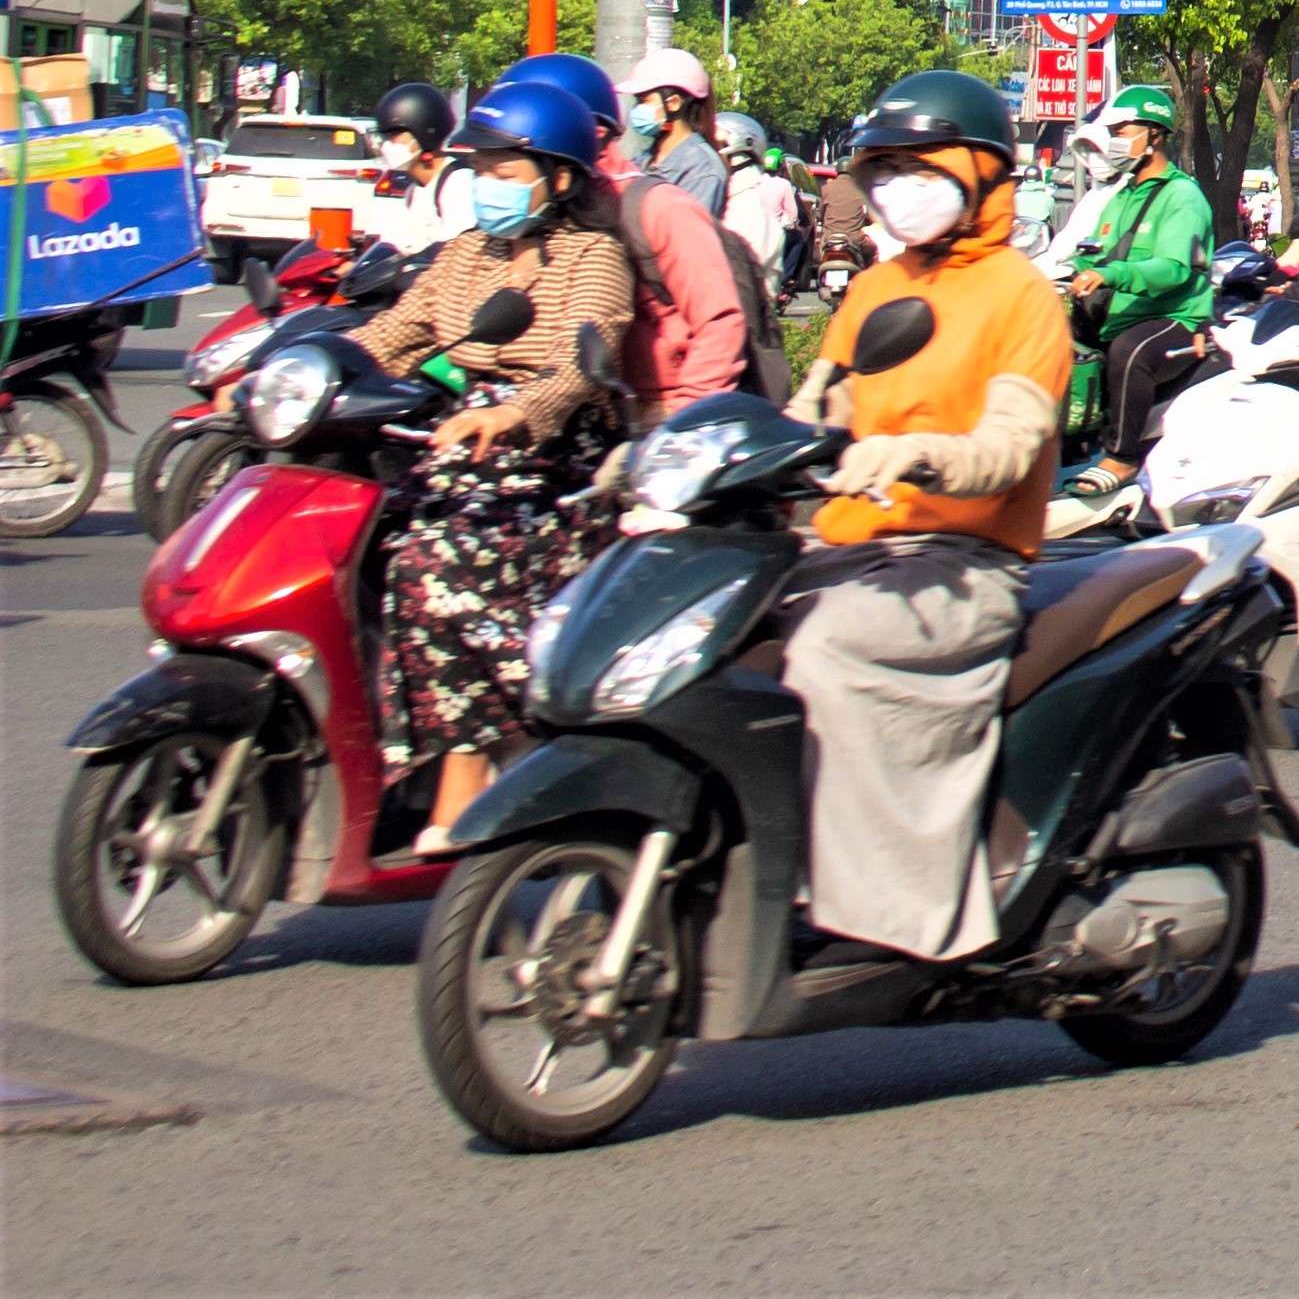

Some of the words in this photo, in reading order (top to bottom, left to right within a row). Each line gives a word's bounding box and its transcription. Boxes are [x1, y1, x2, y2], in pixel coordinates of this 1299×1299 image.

[1056, 50, 1077, 71] CẤ
[1038, 75, 1051, 92] CÁC
[1067, 79, 1077, 92] XE
[27, 221, 141, 260] Lazada
